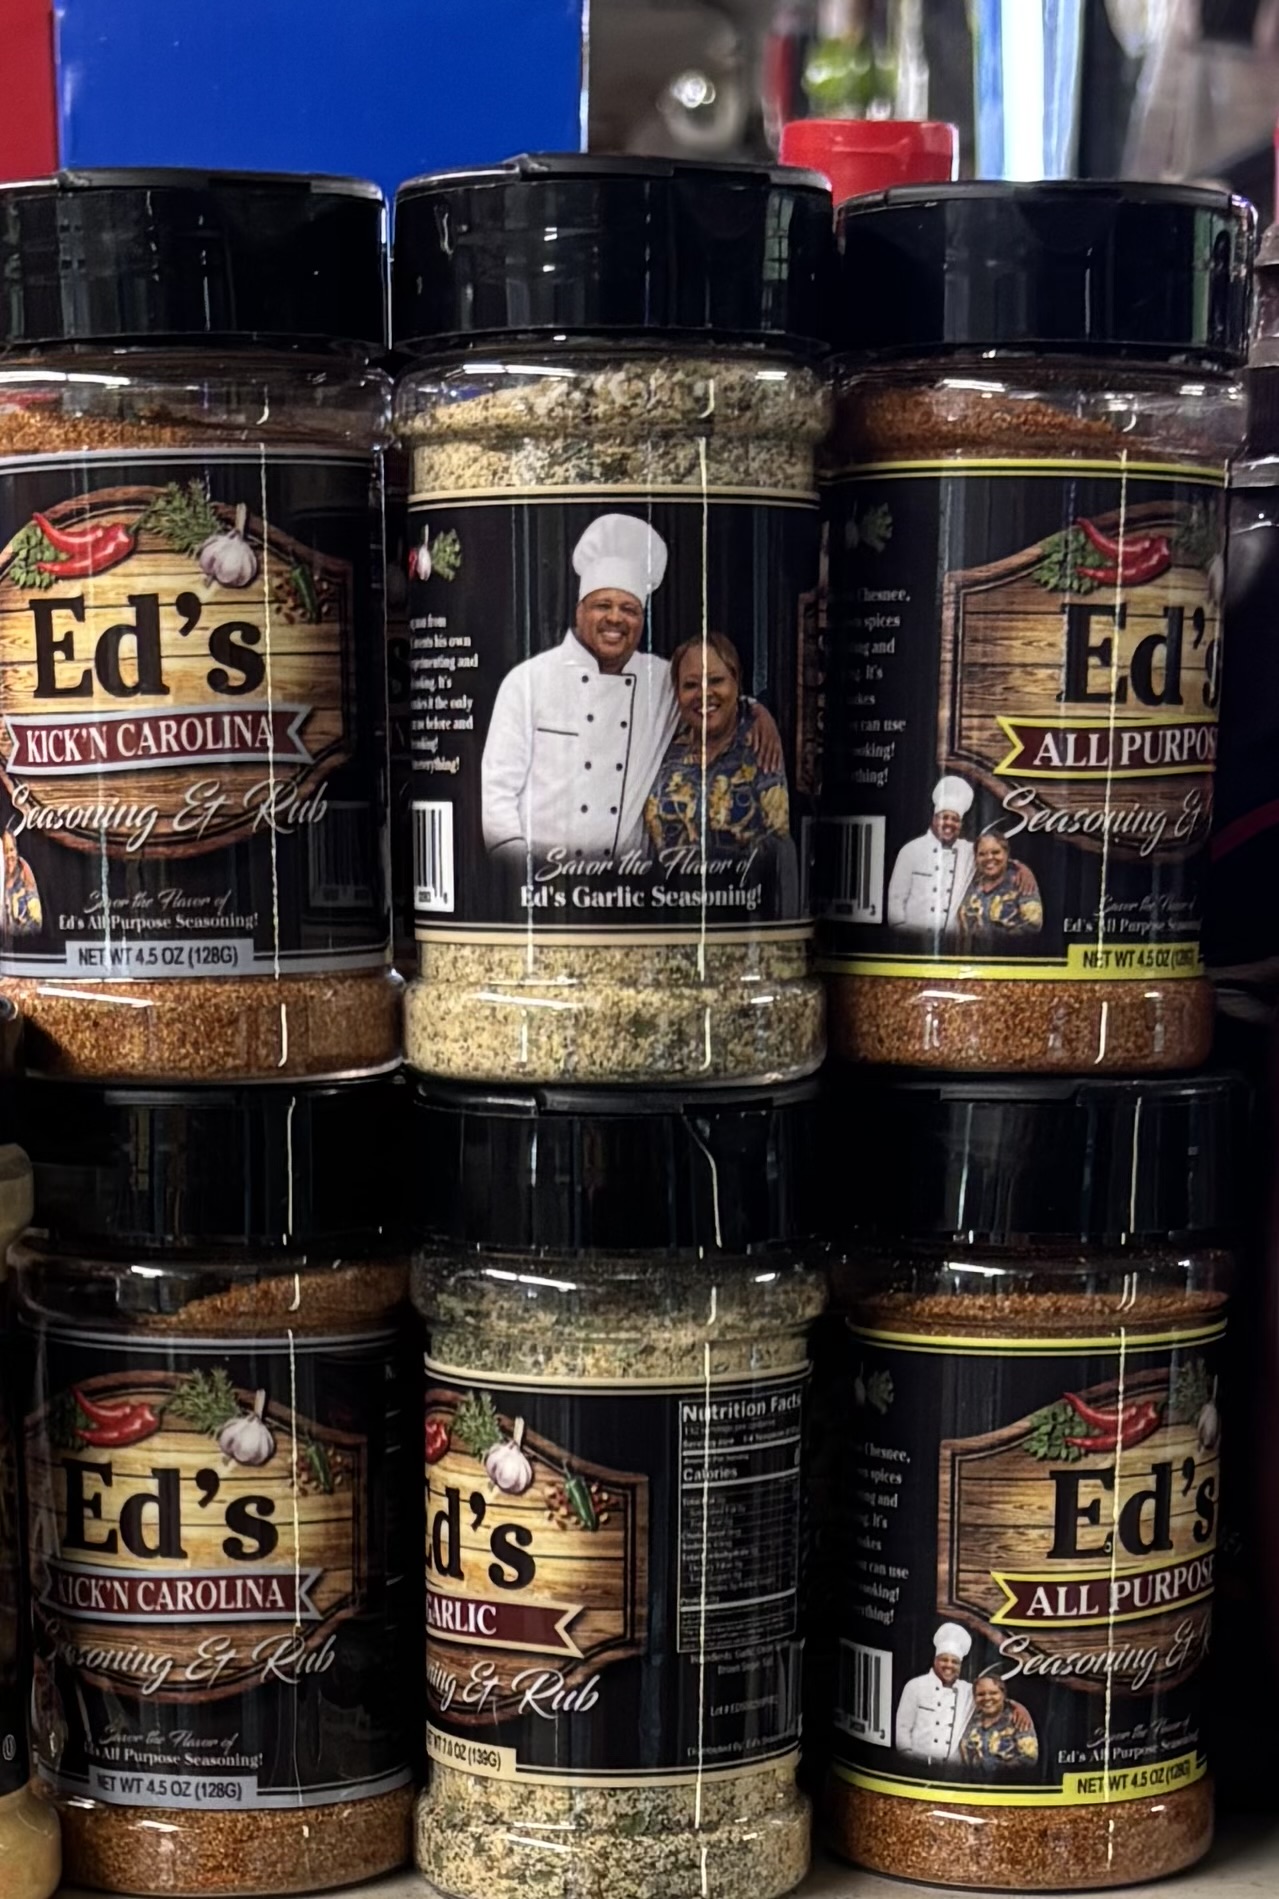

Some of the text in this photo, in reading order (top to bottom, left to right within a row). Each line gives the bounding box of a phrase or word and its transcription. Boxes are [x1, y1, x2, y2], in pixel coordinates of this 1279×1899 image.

[29, 591, 265, 698] Ed's
[872, 637, 895, 654] and
[457, 653, 478, 668] and
[453, 714, 474, 730] and
[884, 719, 906, 732] use
[26, 714, 271, 763] KICK'N CAROLINA
[1033, 727, 1217, 766] ALL PURPOS
[6, 784, 159, 852] Seasoning
[244, 778, 329, 835] Rub
[981, 787, 1167, 856] Seasoning
[535, 845, 758, 888] Savor the Flavor of
[158, 888, 210, 912] Flavor
[214, 889, 232, 915] of
[520, 884, 762, 911] Ed's Garlic Seasoning!
[59, 914, 84, 930] Ed's
[112, 915, 171, 933] Purpose
[176, 913, 258, 930] Seasoning!
[78, 945, 238, 969] NET WT 4.5 OZ (128G)
[1115, 951, 1135, 967] WT
[683, 1399, 766, 1423] Nutrition
[61, 1458, 279, 1561] Ed's
[878, 1493, 898, 1508] and
[1046, 1456, 1216, 1559] Ed's
[426, 1480, 536, 1590] d's
[889, 1565, 909, 1580] use
[137, 1579, 285, 1611] CAROLINA
[1026, 1585, 1099, 1617] ALL
[251, 1632, 337, 1685] Rub
[980, 1634, 1159, 1691] Seasoning
[511, 1668, 600, 1719] Rub
[221, 1733, 239, 1755] of
[1058, 1750, 1086, 1764] Ed's
[124, 1748, 181, 1766] Purpose
[184, 1751, 263, 1769] Seasoning!
[120, 1776, 143, 1794] WT
[147, 1778, 167, 1796] 4.5
[170, 1780, 191, 1797] OZ
[195, 1781, 242, 1801] (128G)
[1077, 1779, 1104, 1794] NET
[1108, 1775, 1129, 1791] WT
[1130, 1771, 1148, 1787] 4.5
[1150, 1767, 1165, 1785] OZ
